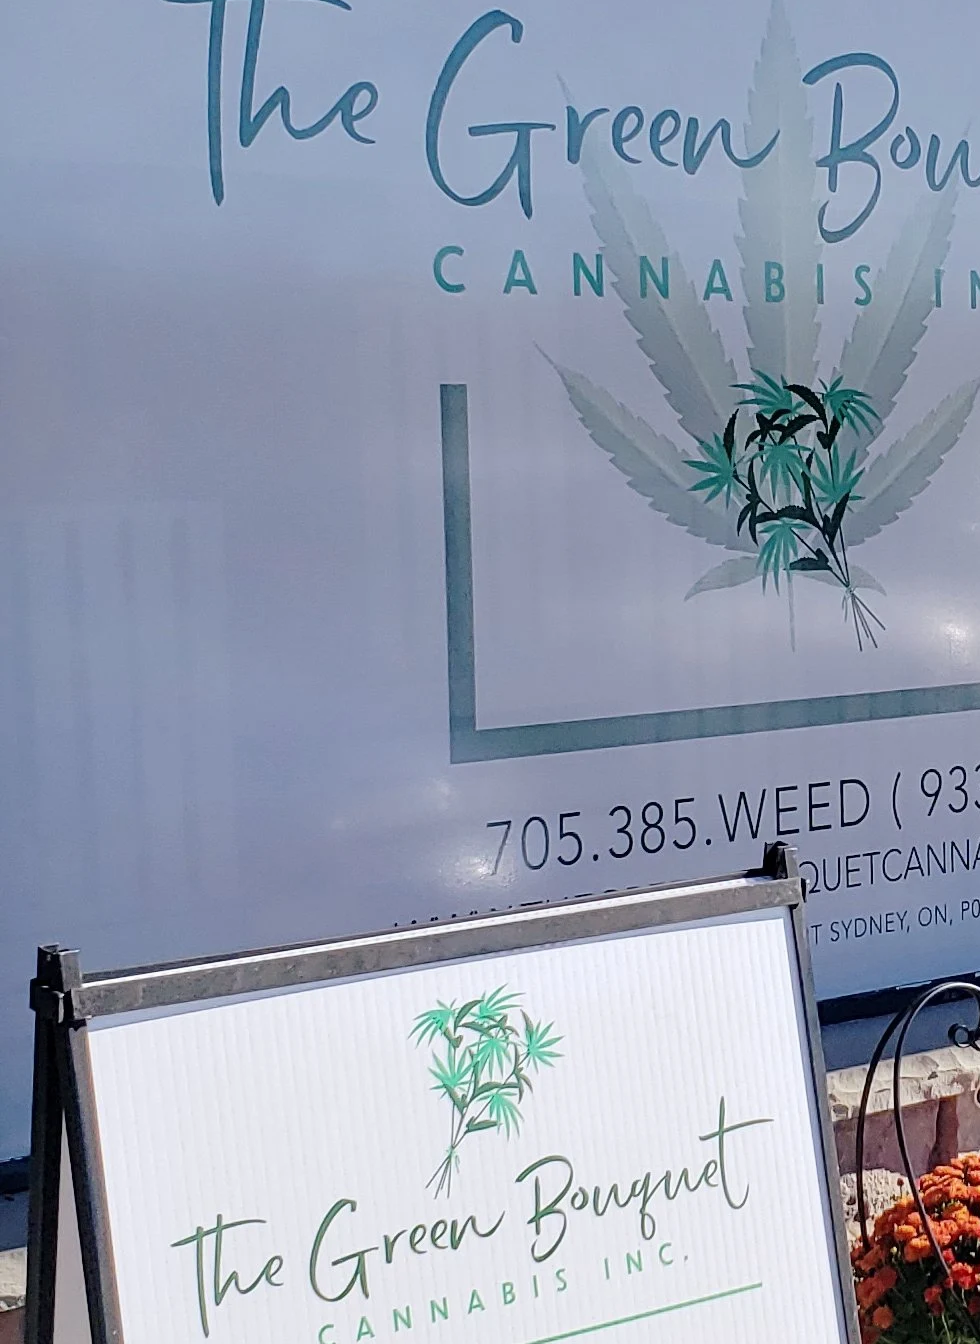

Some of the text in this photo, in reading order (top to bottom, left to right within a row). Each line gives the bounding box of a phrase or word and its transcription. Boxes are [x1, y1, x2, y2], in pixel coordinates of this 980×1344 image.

[426, 9, 780, 219] Green
[432, 245, 872, 306] CANNABIS
[486, 777, 870, 876] 705.385.WEED
[831, 910, 910, 943] SYDNEY,
[918, 904, 953, 927] ON,
[170, 1096, 775, 1338] The Green Bouquet
[604, 1241, 691, 1284] INC.
